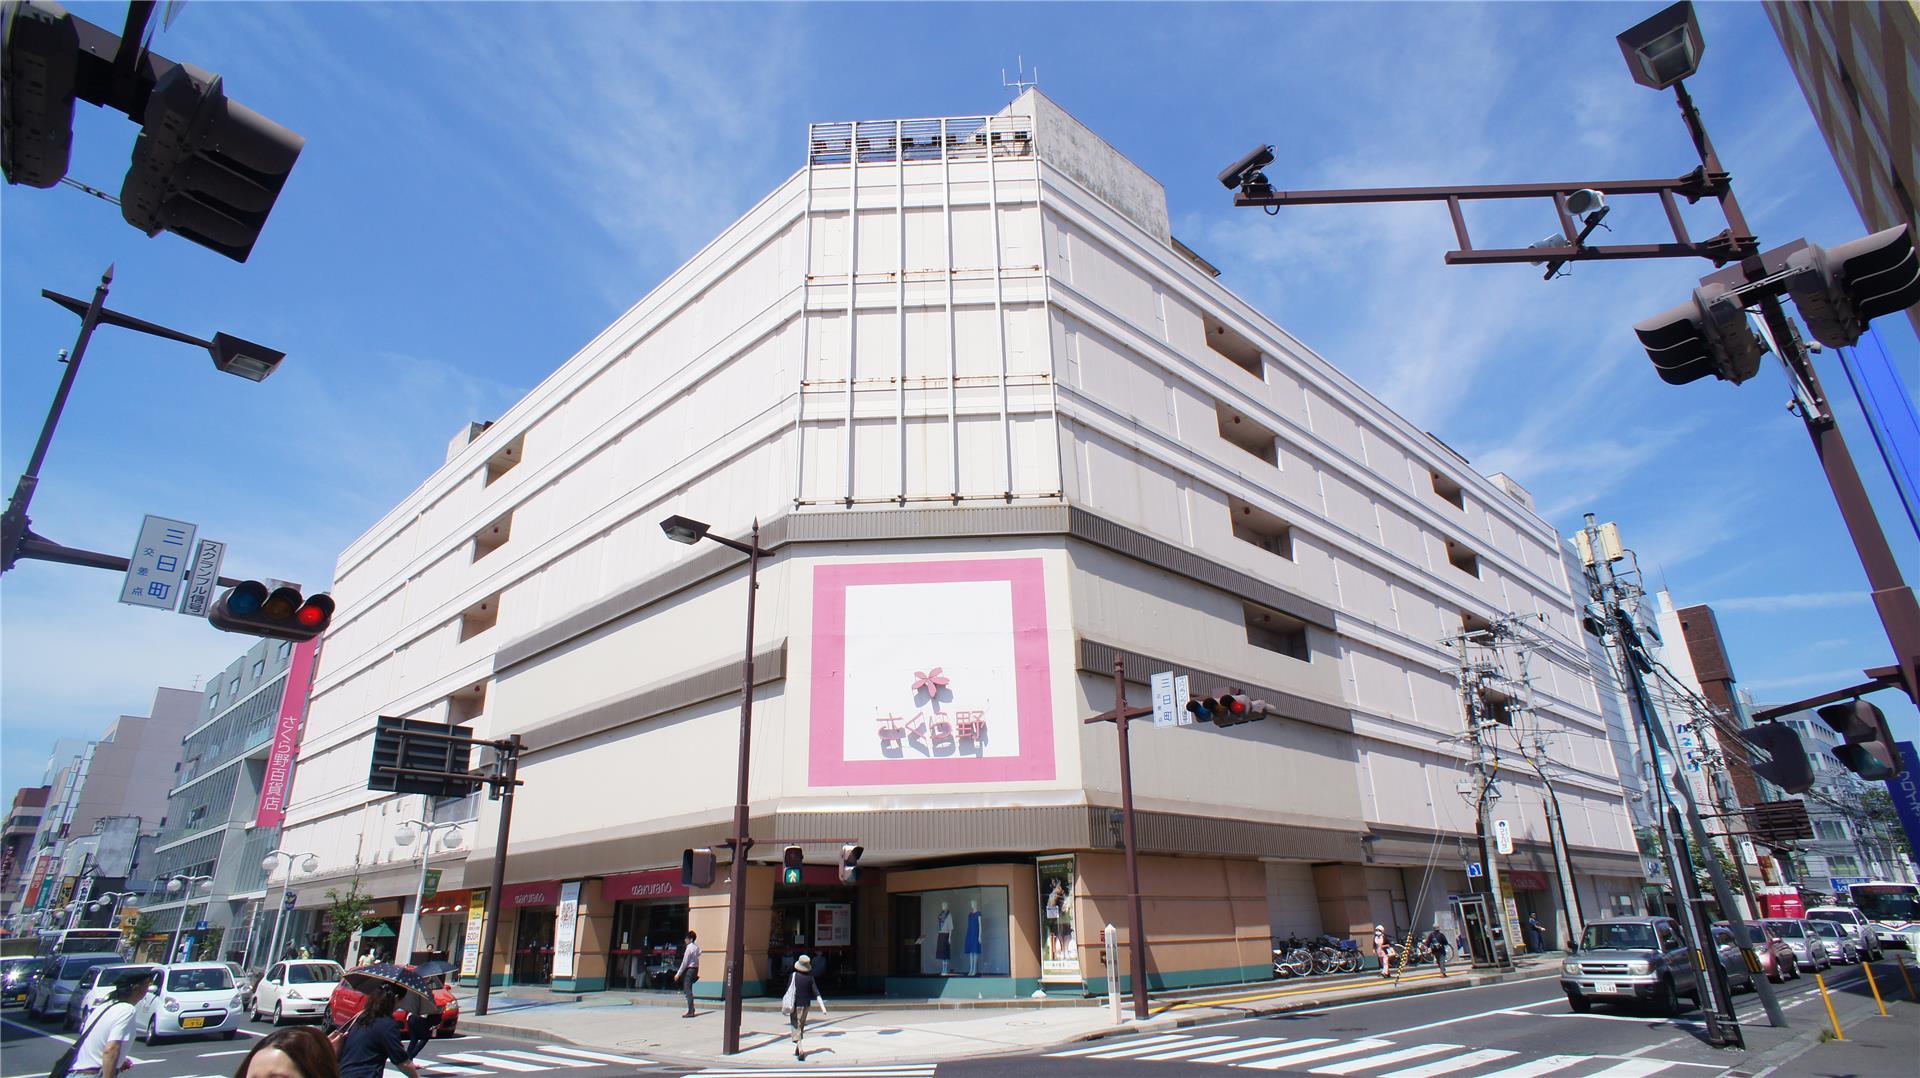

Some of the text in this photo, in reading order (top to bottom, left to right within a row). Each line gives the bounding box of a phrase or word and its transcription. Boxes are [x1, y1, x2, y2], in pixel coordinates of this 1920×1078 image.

[131, 547, 155, 597] 交差点
[148, 528, 185, 600] 三日町
[1161, 677, 1172, 721] 三日町
[875, 710, 986, 741] さくら野
[263, 715, 298, 811] さくら野百貨店
